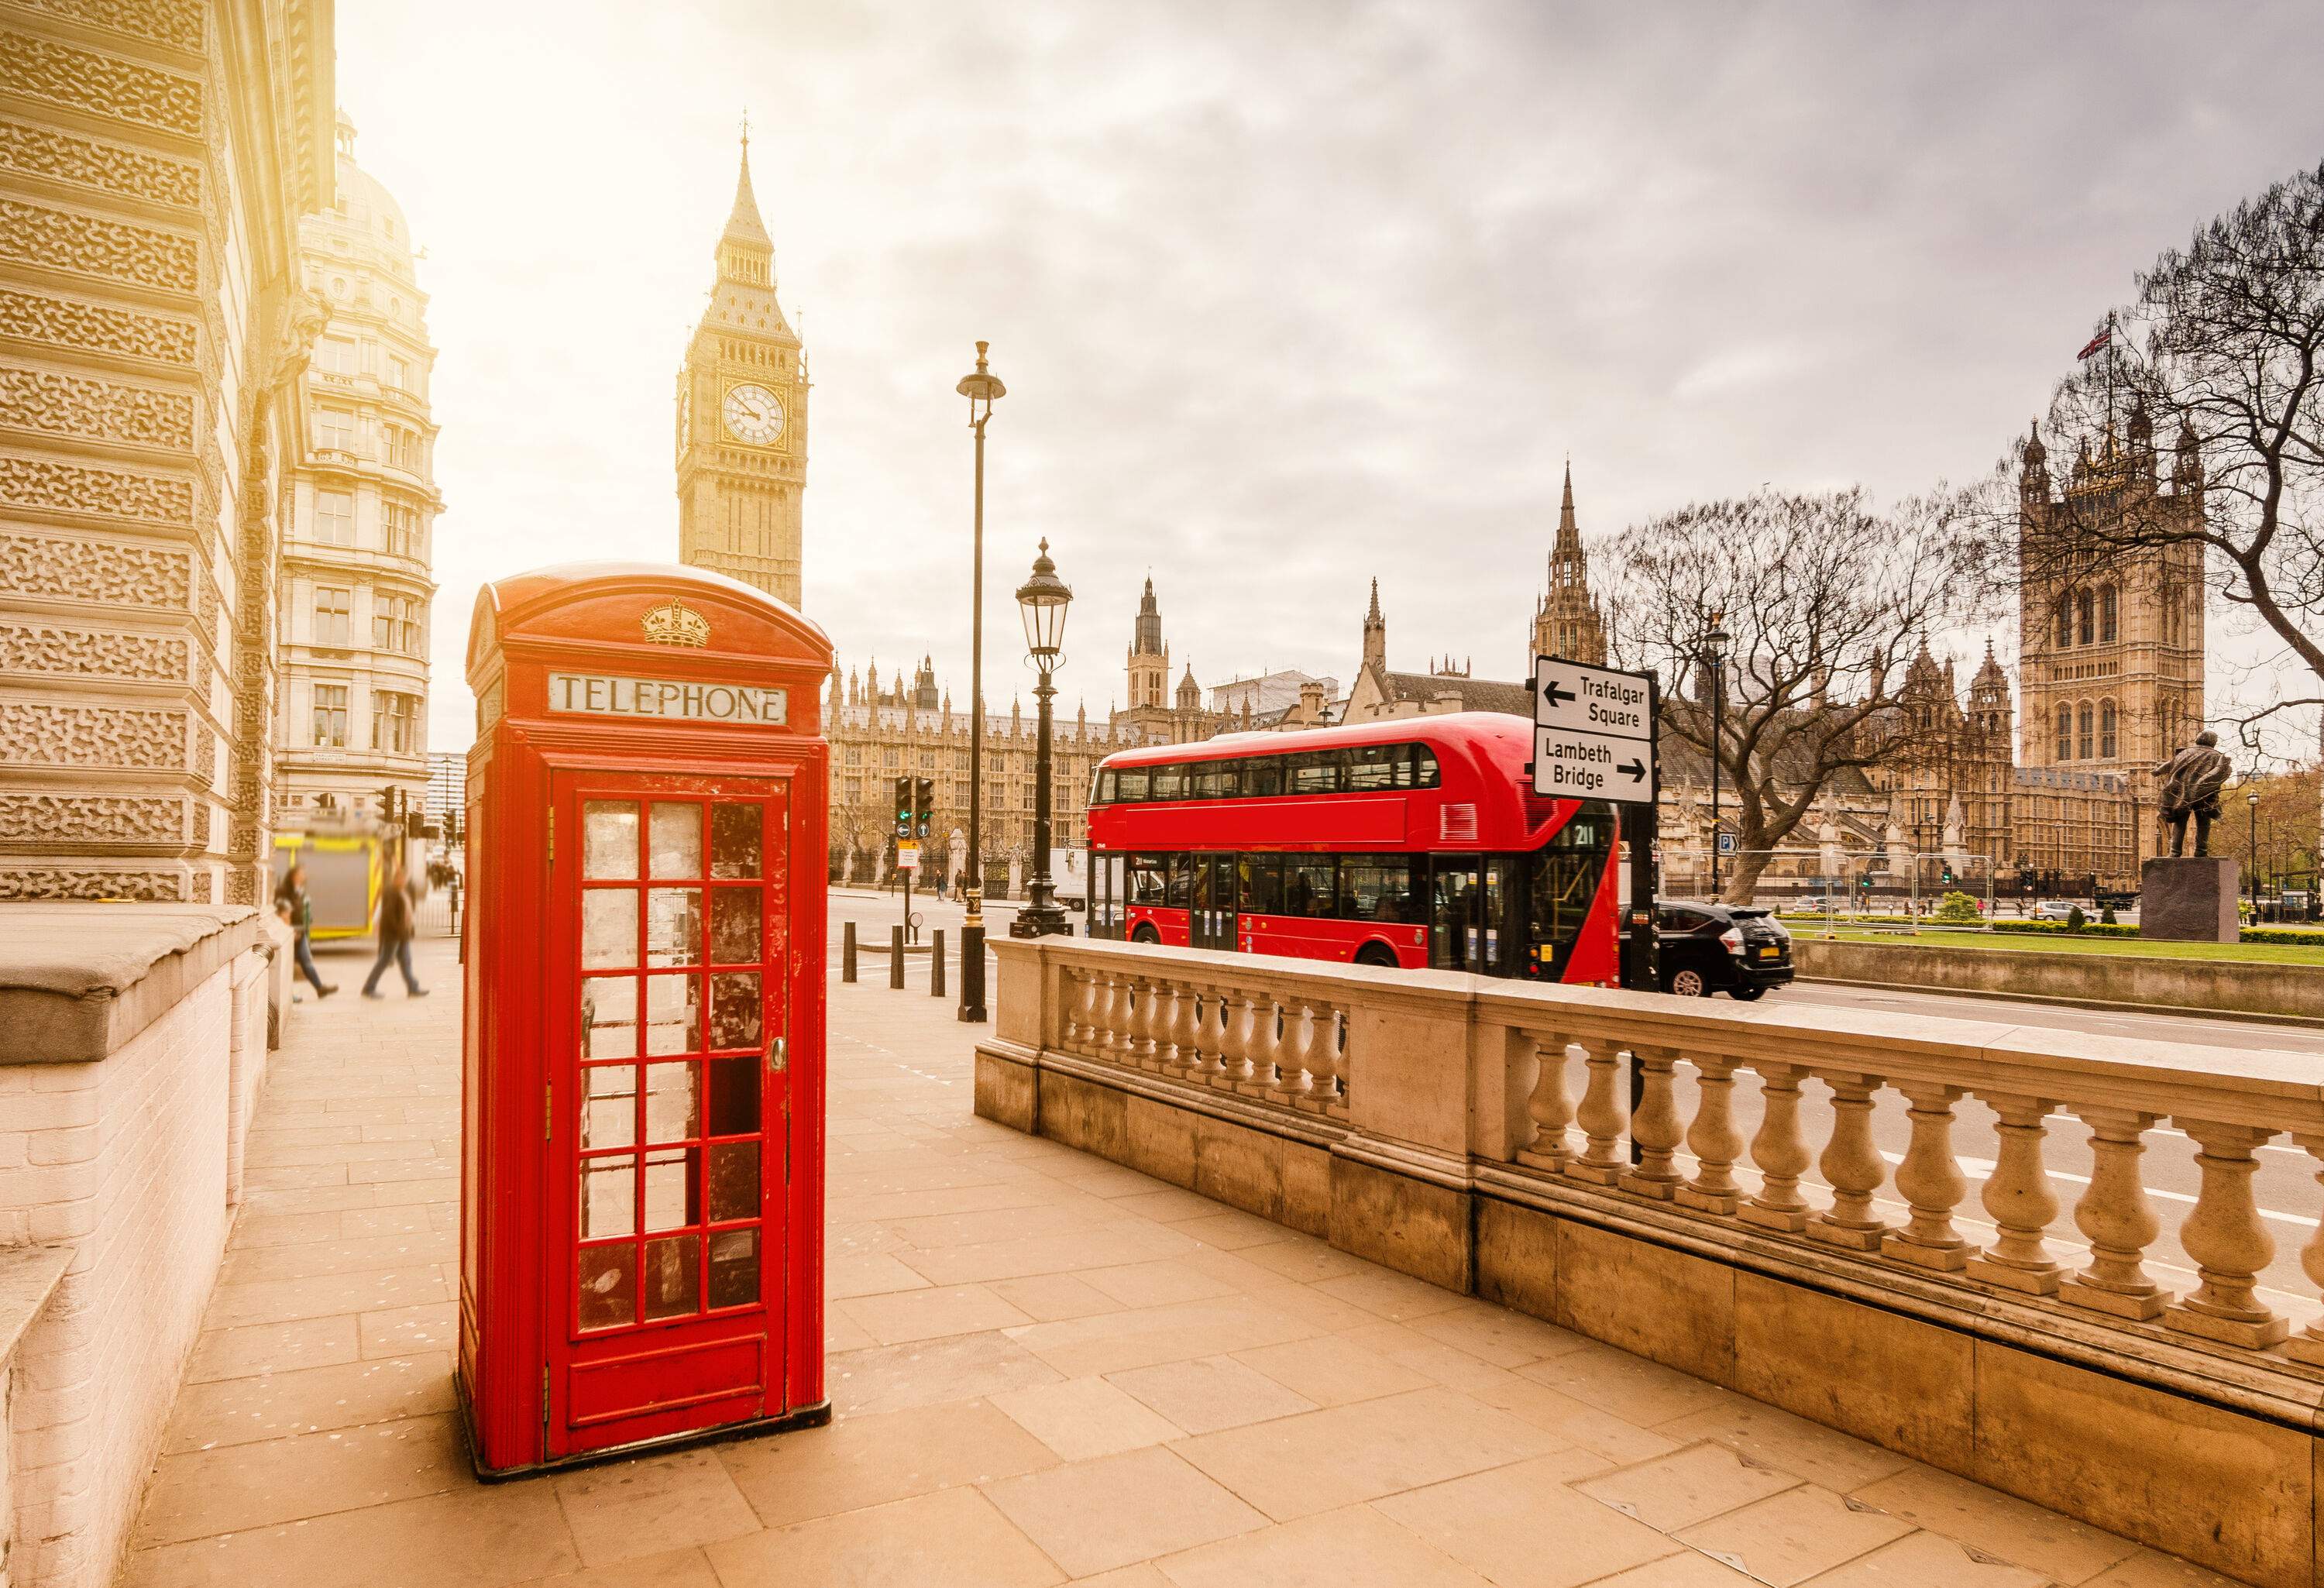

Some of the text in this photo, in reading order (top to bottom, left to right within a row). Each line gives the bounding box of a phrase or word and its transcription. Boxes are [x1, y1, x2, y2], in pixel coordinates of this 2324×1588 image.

[557, 676, 780, 721] TELEPHONE
[1580, 676, 1644, 706] Trafalgar
[1588, 703, 1639, 727] Square
[1545, 737, 1611, 763] Lambeth
[1554, 765, 1604, 790] Bridge
[1574, 825, 1593, 844] 211
[1722, 837, 1728, 848] P
